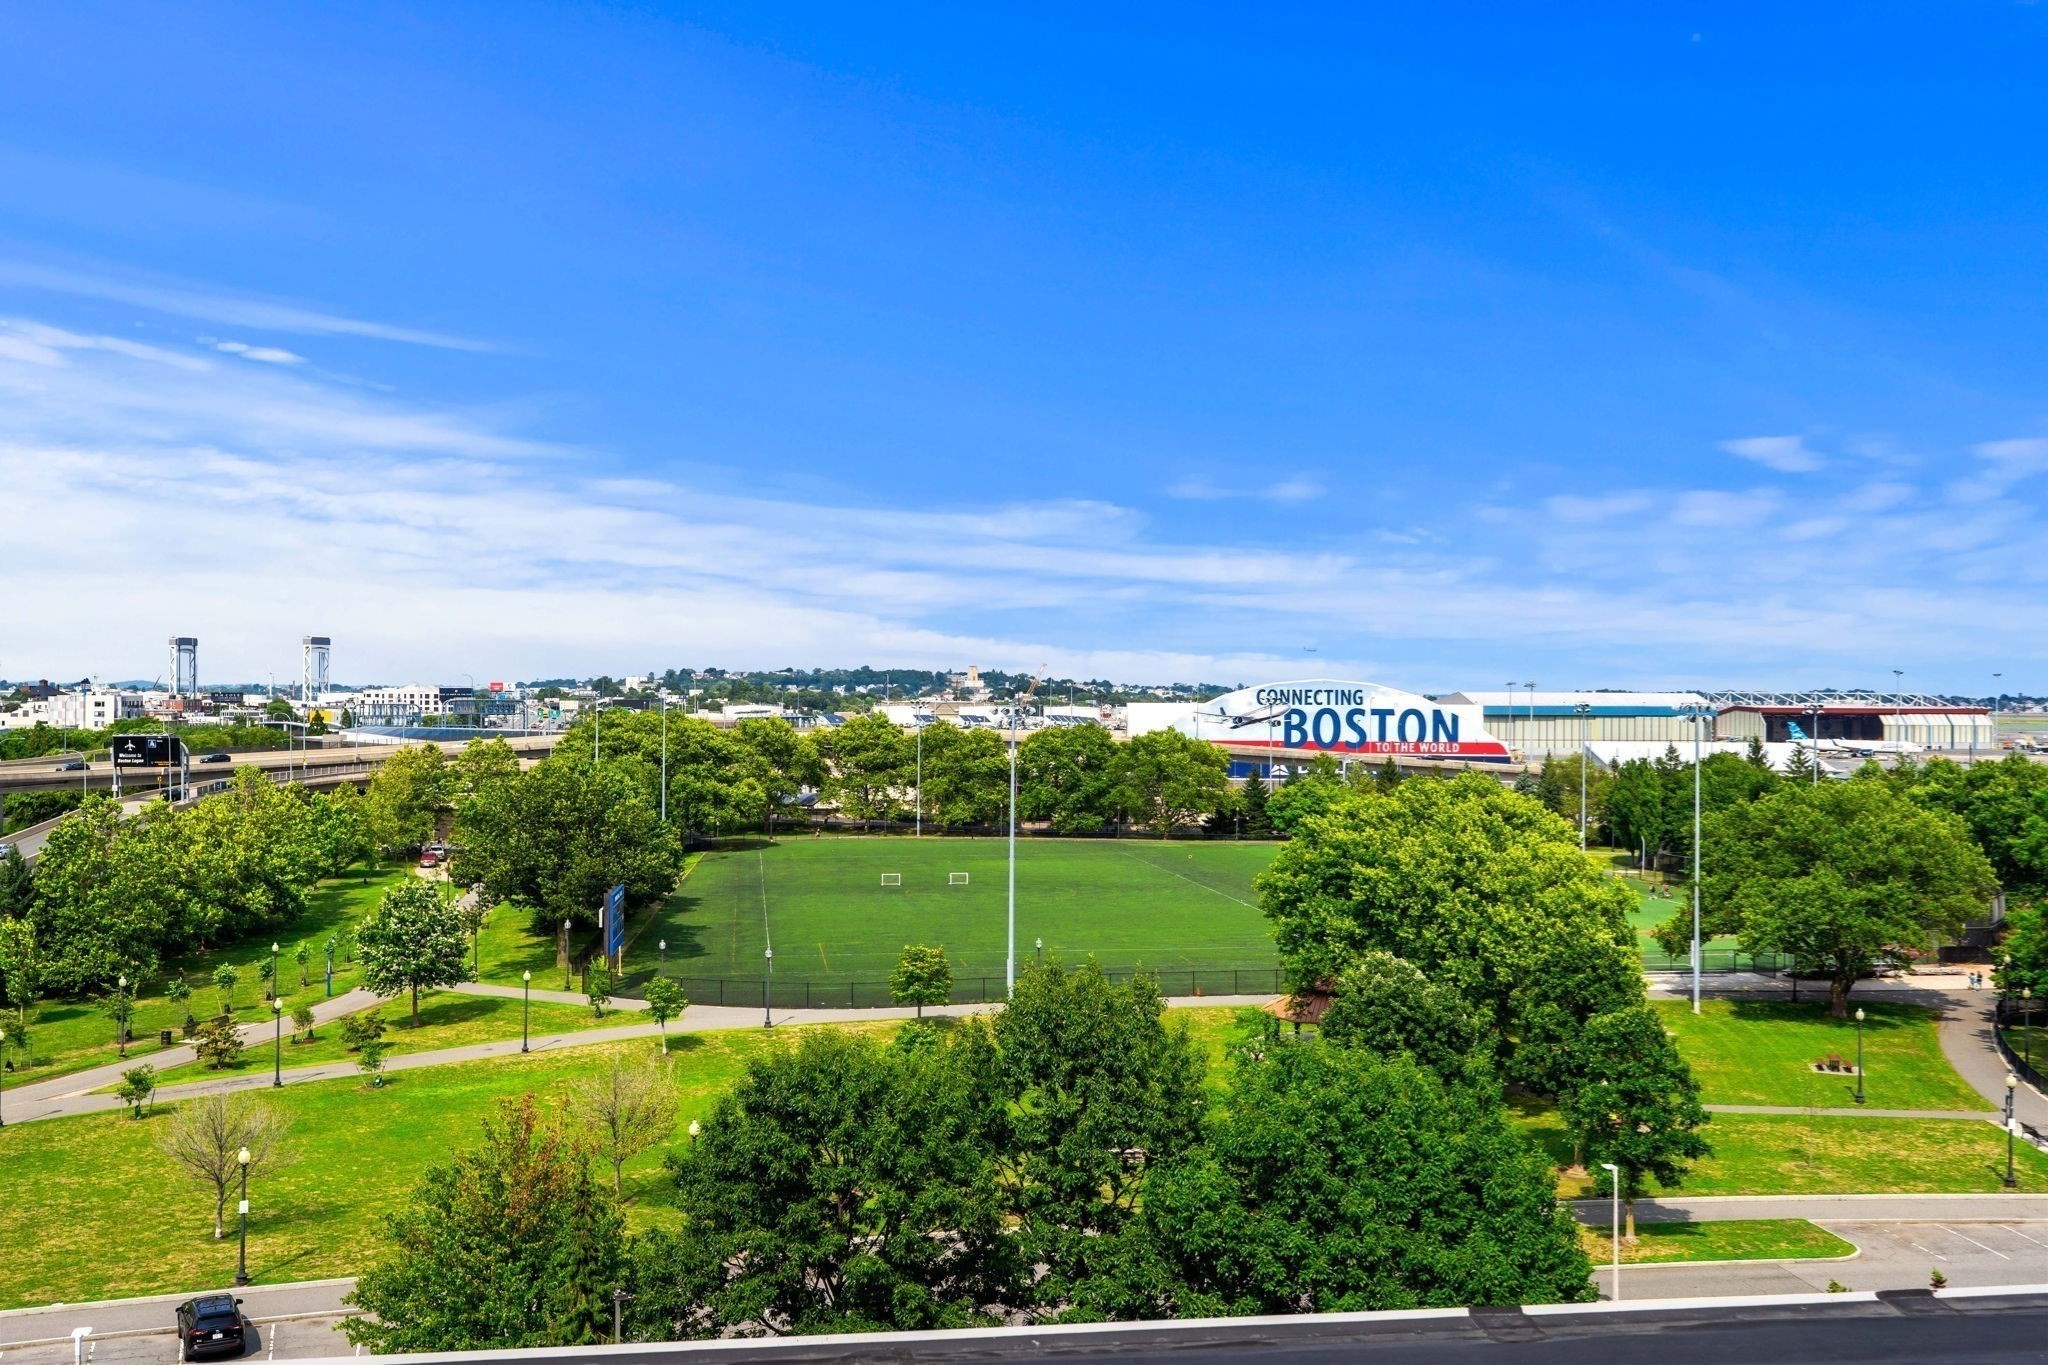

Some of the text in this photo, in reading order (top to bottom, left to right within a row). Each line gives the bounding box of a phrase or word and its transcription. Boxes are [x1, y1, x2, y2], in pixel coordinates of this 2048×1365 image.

[1256, 689, 1364, 706] CONNECTING
[1284, 707, 1459, 749] BOSTON
[1375, 742, 1460, 753] TO THE WORLD
